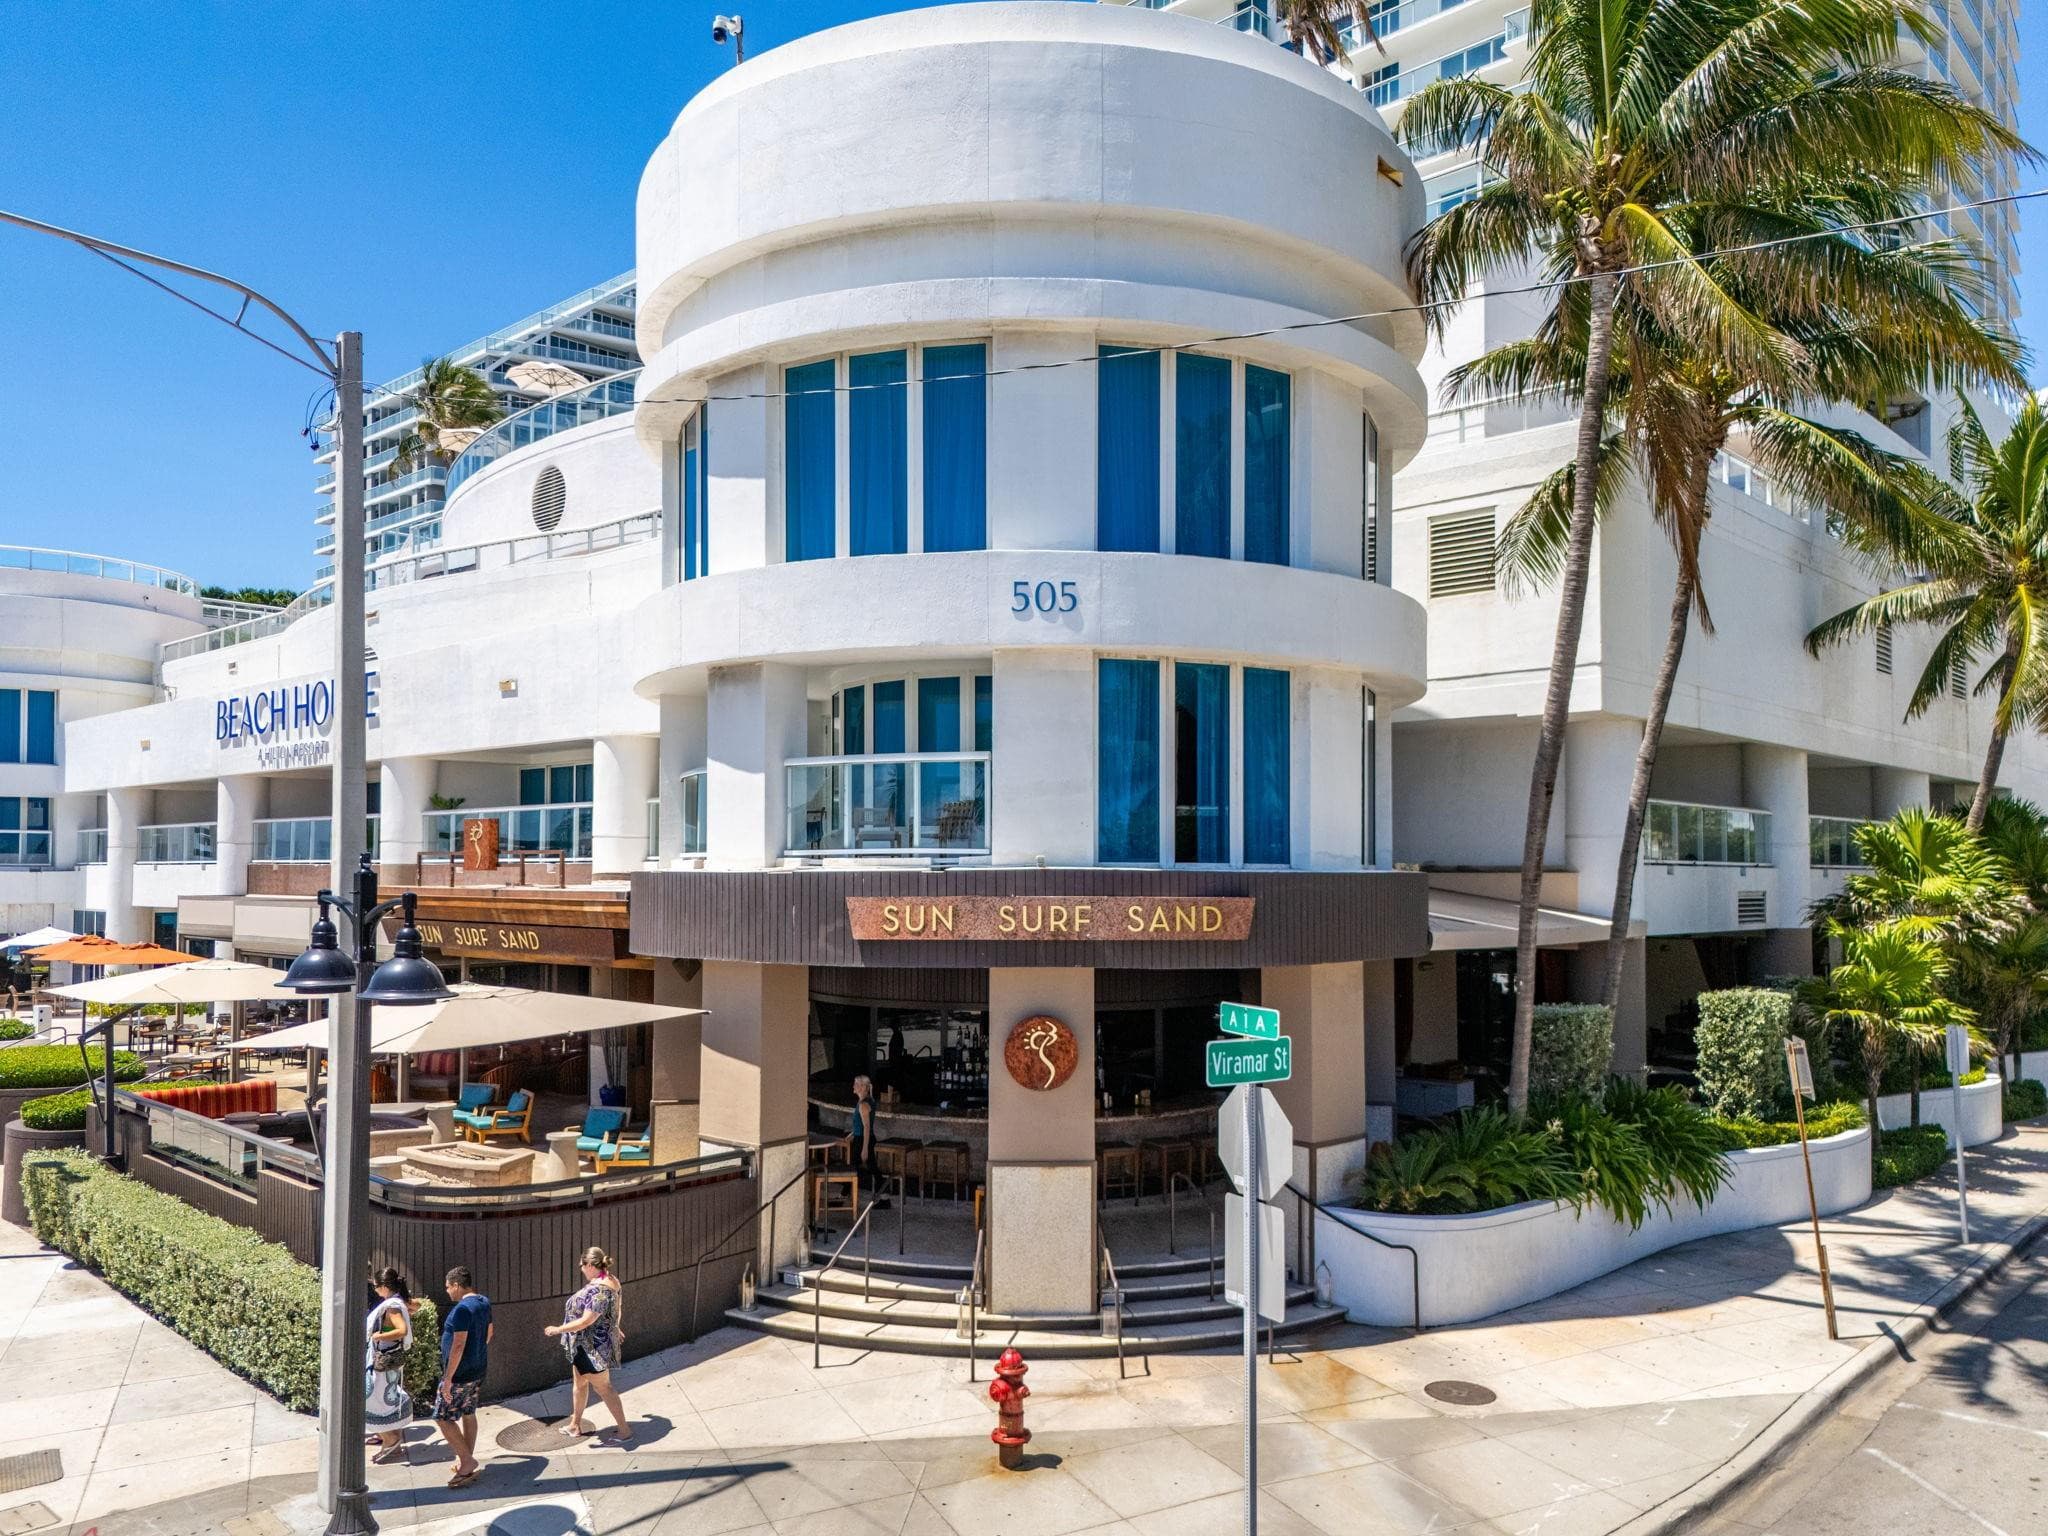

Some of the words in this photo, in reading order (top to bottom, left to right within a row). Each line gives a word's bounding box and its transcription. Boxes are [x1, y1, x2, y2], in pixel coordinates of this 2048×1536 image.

[1011, 581, 1077, 612] 505
[216, 688, 286, 740] BEACH
[294, 671, 377, 728] HOE
[258, 747, 263, 760] A
[293, 741, 328, 758] RESORT
[882, 905, 954, 933] SUN
[998, 904, 1092, 932] SURF
[1127, 905, 1222, 932] SAND
[416, 924, 444, 944] SUN
[454, 926, 488, 947] SURF
[499, 929, 540, 950] SAND
[1212, 1051, 1269, 1076] Viramar
[1274, 1046, 1288, 1071] St
